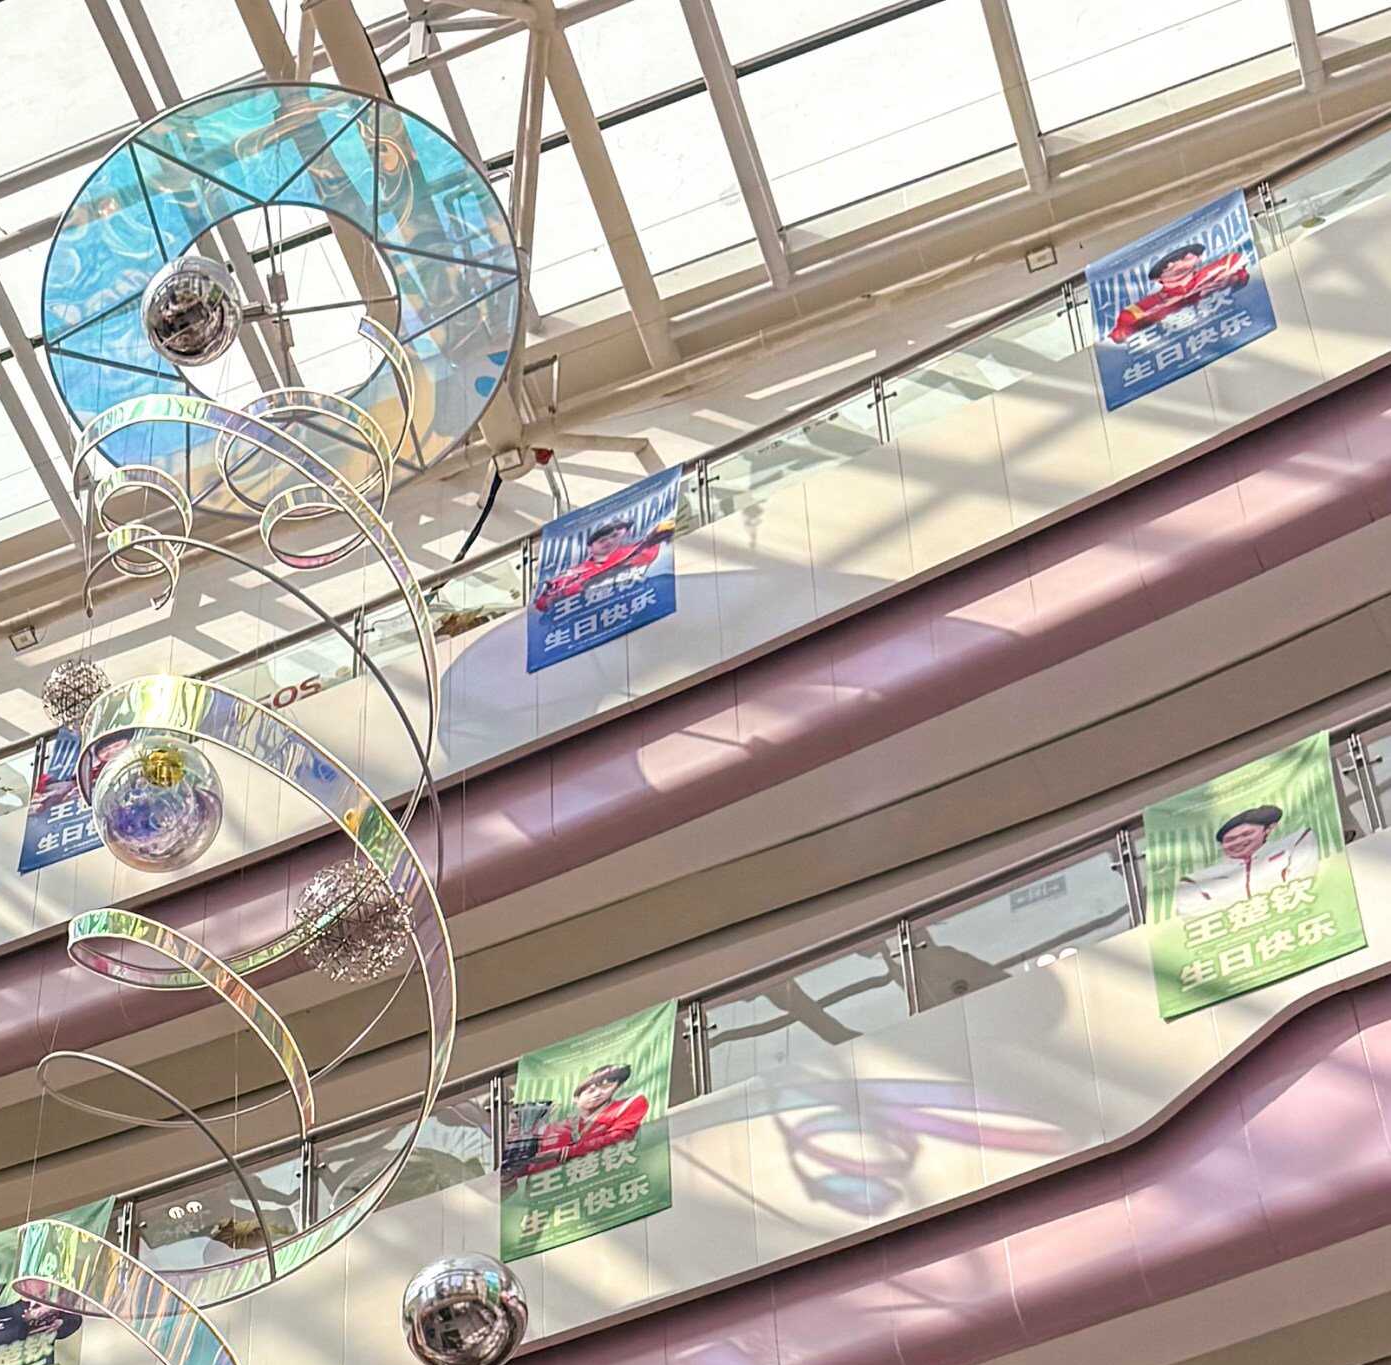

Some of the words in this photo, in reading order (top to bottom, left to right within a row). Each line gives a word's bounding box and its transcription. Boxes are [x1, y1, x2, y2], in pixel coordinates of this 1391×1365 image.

[1122, 310, 1252, 387] 生日快乐
[1126, 289, 1236, 355] 王楚钦
[543, 588, 657, 652] 生日快乐
[553, 566, 649, 621] 王楚钦
[35, 820, 101, 856] 生日
[1183, 876, 1316, 949] 王楚钦
[1179, 913, 1337, 992] 生日快乐
[529, 1138, 638, 1198] 王楚钦
[519, 1174, 650, 1238] 生日快乐
